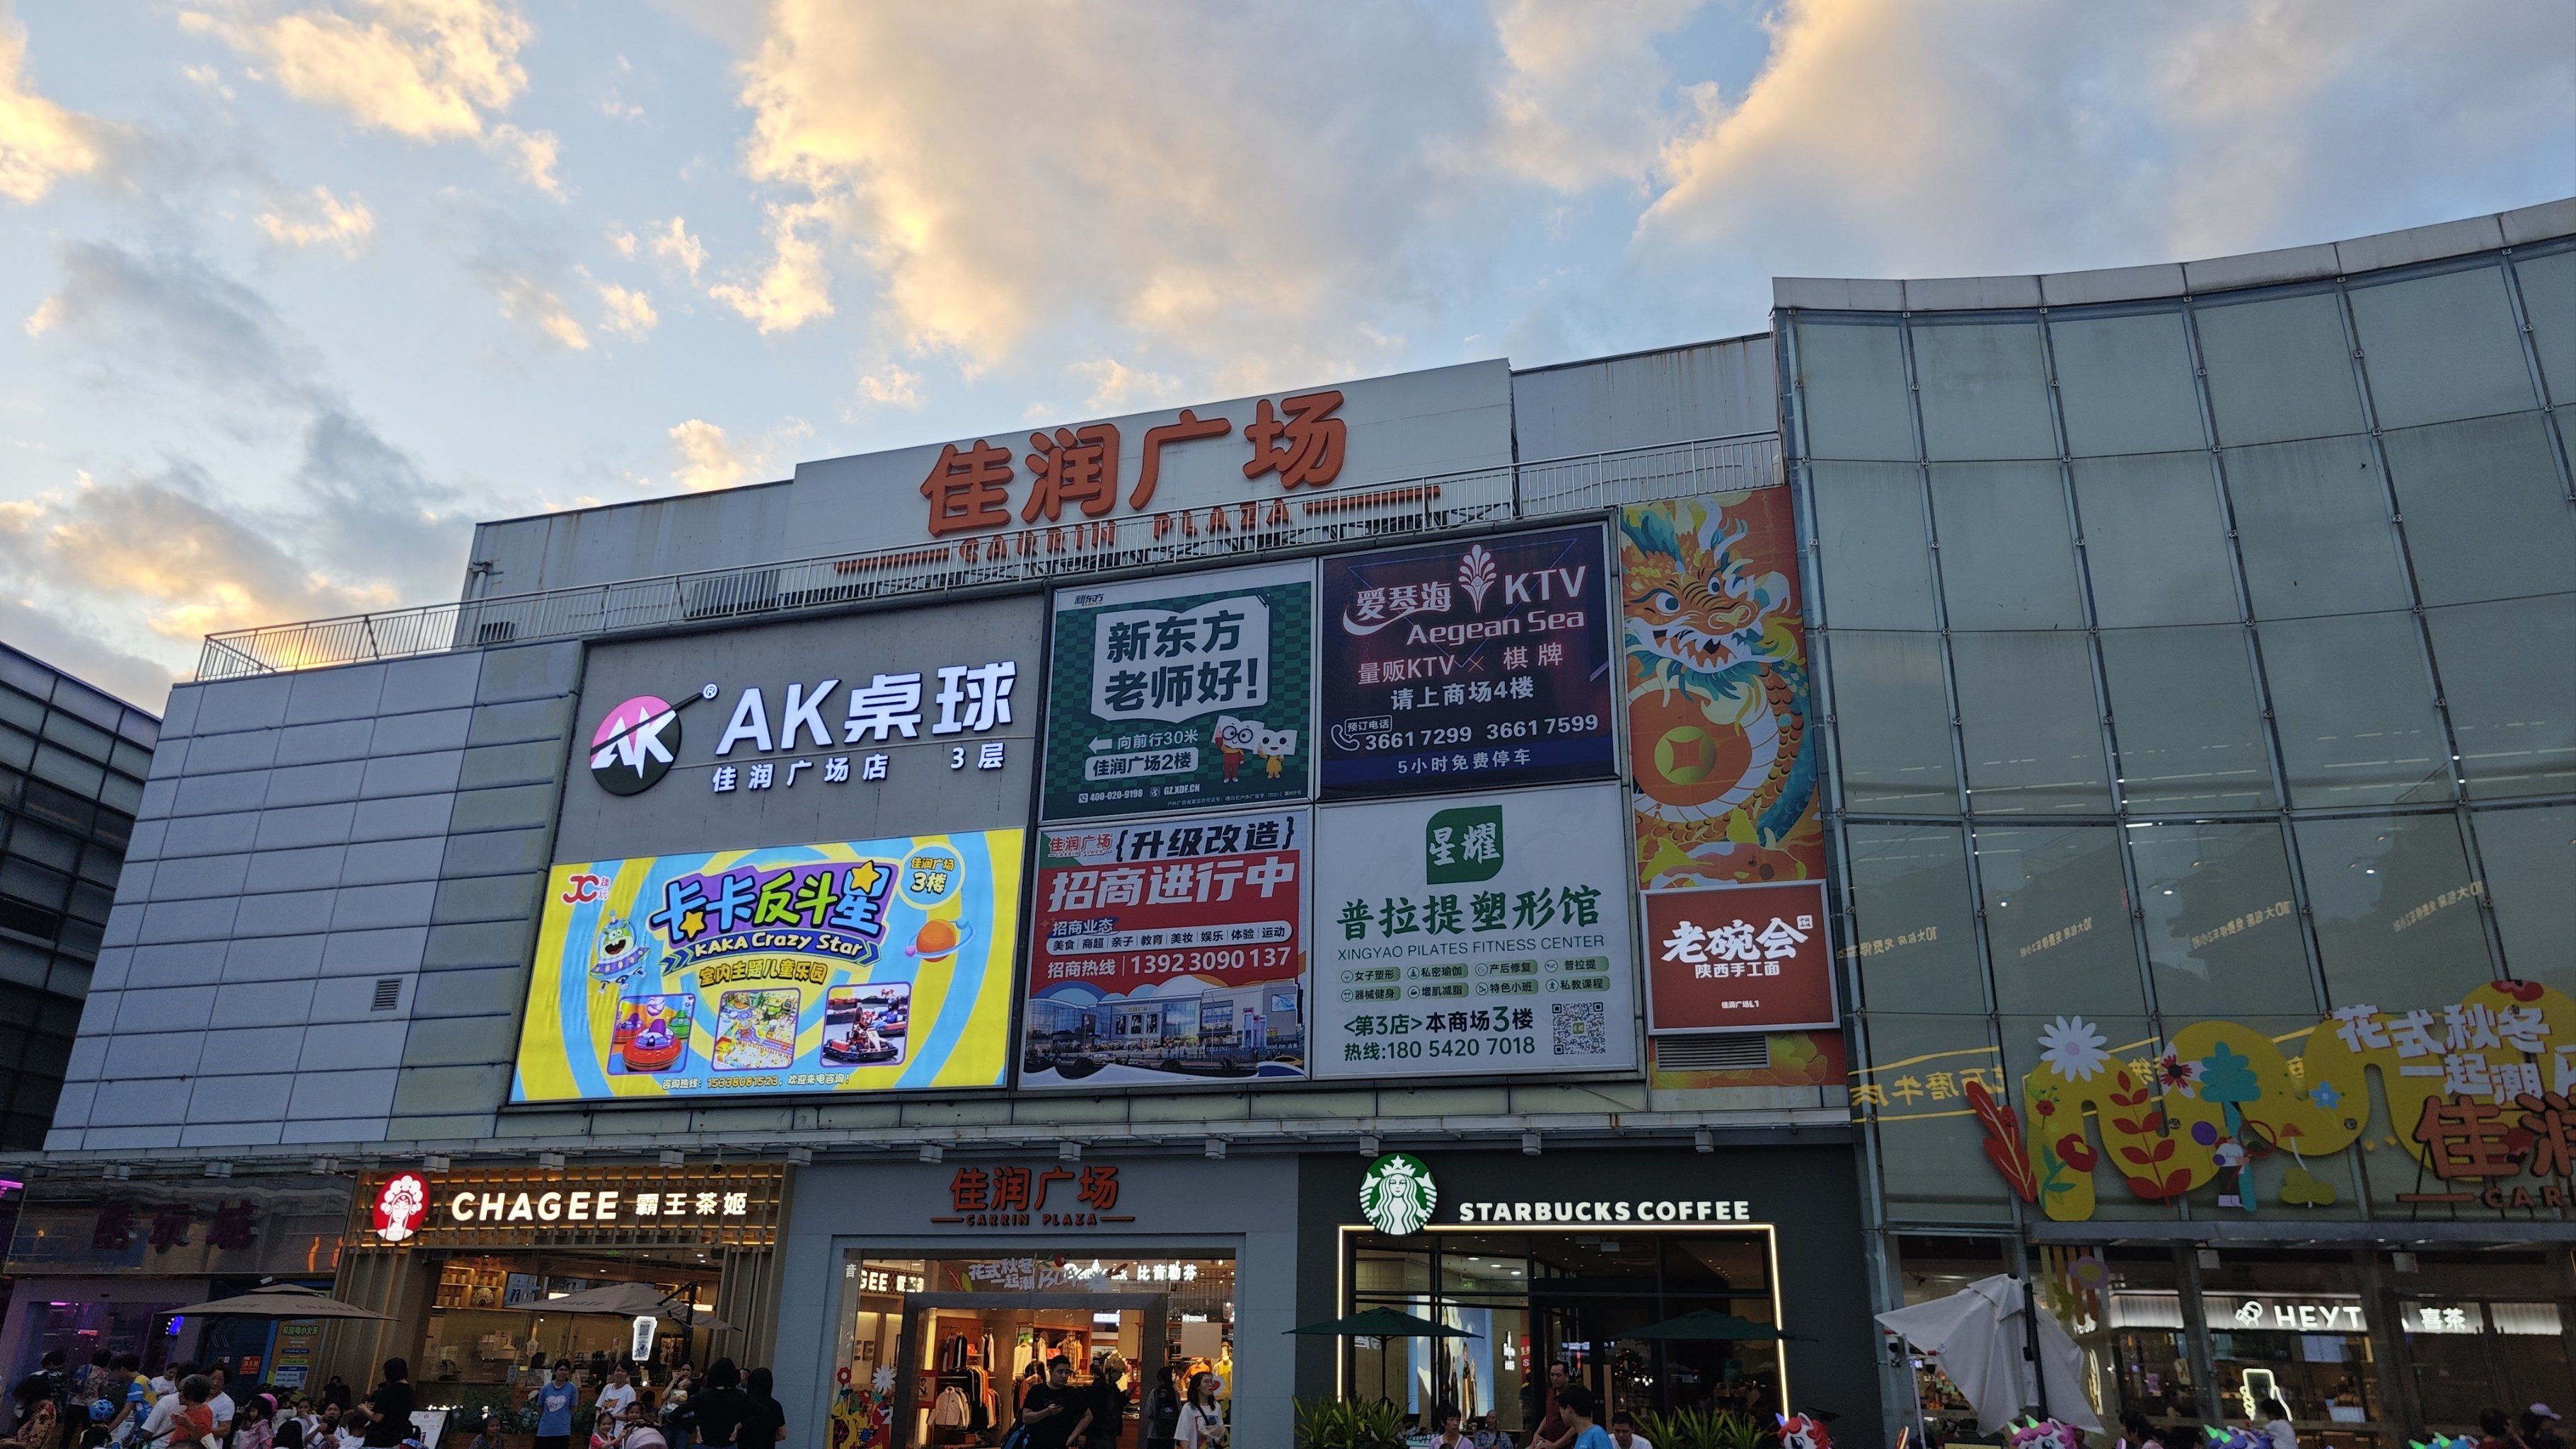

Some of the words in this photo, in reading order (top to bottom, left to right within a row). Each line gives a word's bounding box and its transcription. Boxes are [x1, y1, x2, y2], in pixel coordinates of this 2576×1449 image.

[920, 390, 1348, 538] 佳润广场
[1153, 499, 1290, 541] PLAZA
[1075, 593, 1105, 607] 新东方
[1357, 581, 1451, 621] 爱琴海
[1504, 565, 1586, 605] KTV
[1107, 609, 1245, 664] 新东方
[1406, 617, 1520, 647] Aegean
[1528, 610, 1585, 633] Sea
[1358, 654, 1455, 686] 量贩KTV
[1503, 642, 1564, 671] 棋牌
[1390, 676, 1535, 711] 请上商场4楼
[715, 660, 1017, 755] AK桌球
[1347, 719, 1390, 732] 预订电话
[1365, 732, 1414, 751] 3661
[1421, 726, 1472, 746] 7299
[1486, 720, 1537, 740] 3661
[1544, 713, 1598, 734] 7599
[1117, 729, 1199, 751] 向前行30米
[712, 753, 890, 794] 佳润广场店
[949, 741, 1005, 771] 3层
[1092, 751, 1191, 778] 佳润广场2楼
[1397, 748, 1531, 774] 5小时免费停车
[1090, 787, 1143, 802] 400-020-9198
[1049, 832, 1113, 851] 佳润广场
[1428, 821, 1501, 867] 星耀
[911, 856, 954, 871] 佳润广场
[912, 871, 948, 894] 3楼
[1046, 856, 1297, 913] 招商进行中
[652, 862, 886, 939] 卡卡反斗星
[1336, 884, 1602, 941] 普拉提塑形馆
[1052, 918, 1114, 936] 招商业态
[1053, 939, 1075, 951] 美食
[1082, 937, 1104, 949] 商超
[1111, 936, 1133, 948] 亲子
[1140, 935, 1163, 946] 教育
[1170, 933, 1193, 945] 美妆
[1201, 930, 1223, 942] 娱乐
[1231, 928, 1254, 940] 体验
[1261, 927, 1286, 939] 运动
[1660, 917, 1808, 963] 老碗会
[694, 935, 749, 957] KAKA
[751, 931, 814, 953] Crazy
[818, 933, 864, 959] Star
[1338, 945, 1403, 961] XINGYAO
[1408, 942, 1468, 957] PILATES
[1473, 938, 1536, 953] FITNESS
[1541, 935, 1605, 949] CENTER
[699, 959, 828, 987] 室内主题儿童乐园
[1047, 958, 1116, 979] 招商热线
[1131, 953, 1184, 975] 1392
[1189, 950, 1244, 971] 3090
[1249, 947, 1292, 968] 137
[1354, 969, 1394, 982] 女子塑形
[1421, 966, 1462, 978] 私密瑜伽
[1489, 962, 1532, 974] 产后修复
[1564, 959, 1596, 970] 普拉提
[1695, 961, 1780, 979] 陕西手工面
[1354, 988, 1394, 1000] 器械健身
[1421, 985, 1463, 997] 增肌减脂
[1490, 981, 1532, 994] 特色小班
[1559, 978, 1603, 991] 私教课程
[2333, 1003, 2551, 1058] 花式秋冬
[1428, 1039, 1479, 1057] 5420
[1486, 1036, 1535, 1055] 7018
[2399, 1053, 2544, 1105] 一起潮
[949, 1166, 1119, 1212] 佳润广场
[2483, 1184, 2576, 1209] CAR
[451, 1191, 619, 1222] CHAGEE
[635, 1191, 747, 1217] 霸王茶姬
[1459, 1201, 1631, 1223] STARBUCKS
[1637, 1200, 1751, 1222] COFFEE
[966, 1213, 1029, 1226] CARRIN
[1043, 1213, 1097, 1226] PLAZA
[968, 1257, 1035, 1281] 花式秋冬
[1136, 1261, 1199, 1282] 比音勒芬
[990, 1273, 1035, 1292] 一起潮
[2419, 1307, 2466, 1331] 喜茶
